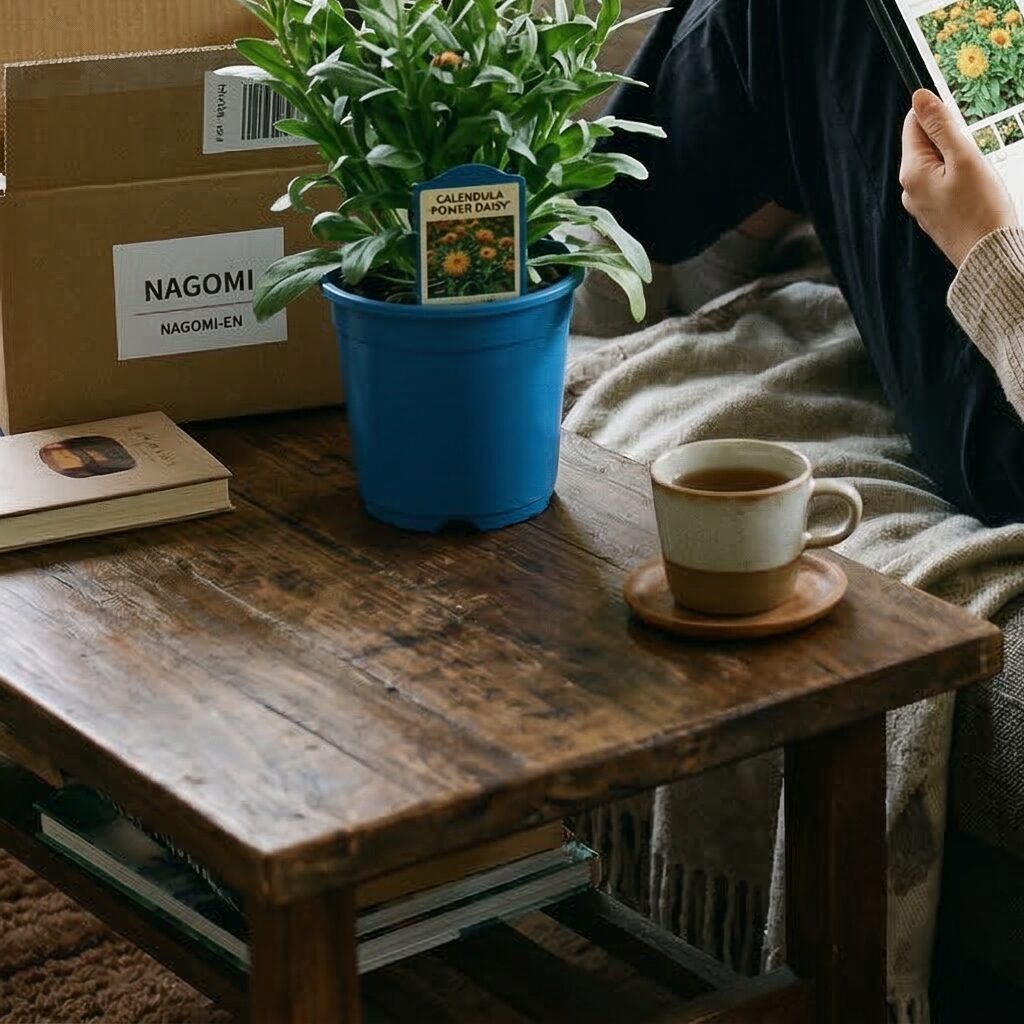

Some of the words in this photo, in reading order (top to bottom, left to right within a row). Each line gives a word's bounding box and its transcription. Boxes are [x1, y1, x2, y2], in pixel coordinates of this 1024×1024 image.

[436, 190, 504, 205] CALENDULA
[475, 199, 511, 214] DAISY
[144, 269, 254, 303] NAGOMI
[160, 314, 243, 336] NAGOMI-EN
